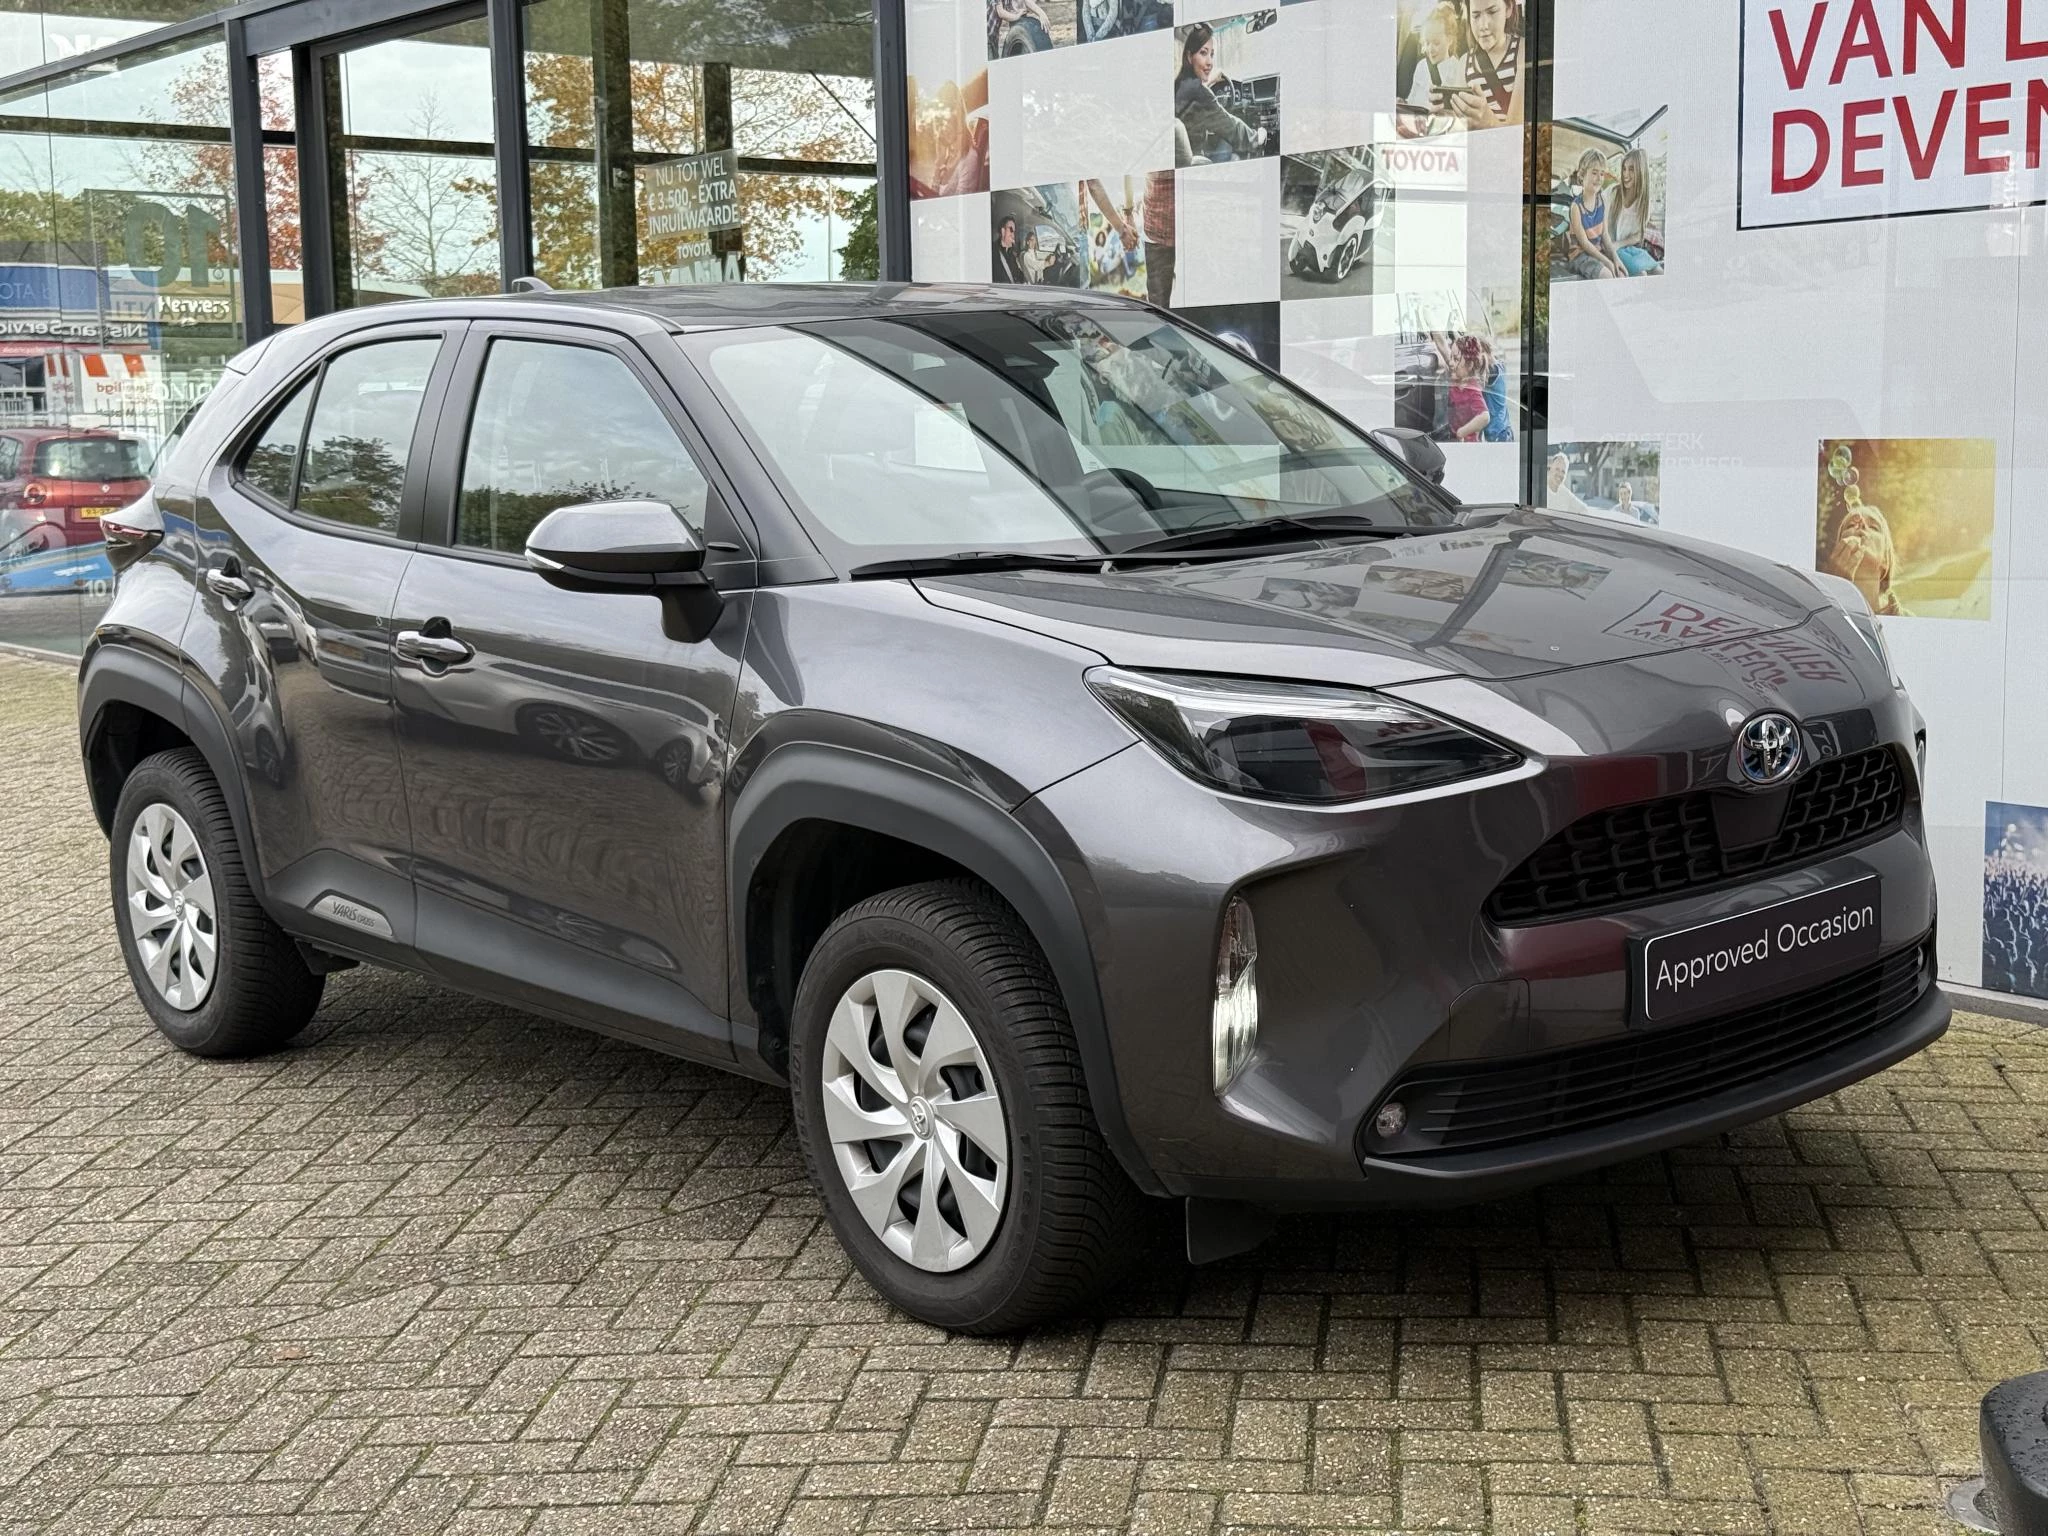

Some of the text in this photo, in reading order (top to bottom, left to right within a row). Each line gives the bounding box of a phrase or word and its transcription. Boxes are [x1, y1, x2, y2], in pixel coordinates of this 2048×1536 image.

[1768, 0, 1967, 91] VAN
[656, 156, 727, 188] NU TOT WEL
[1381, 149, 1459, 172] TOYOTA
[648, 203, 739, 236] INRUILWAARDE
[676, 242, 711, 260] TOYOTA
[332, 901, 358, 921] YARIS
[1656, 905, 1873, 993] Approved Occasion
